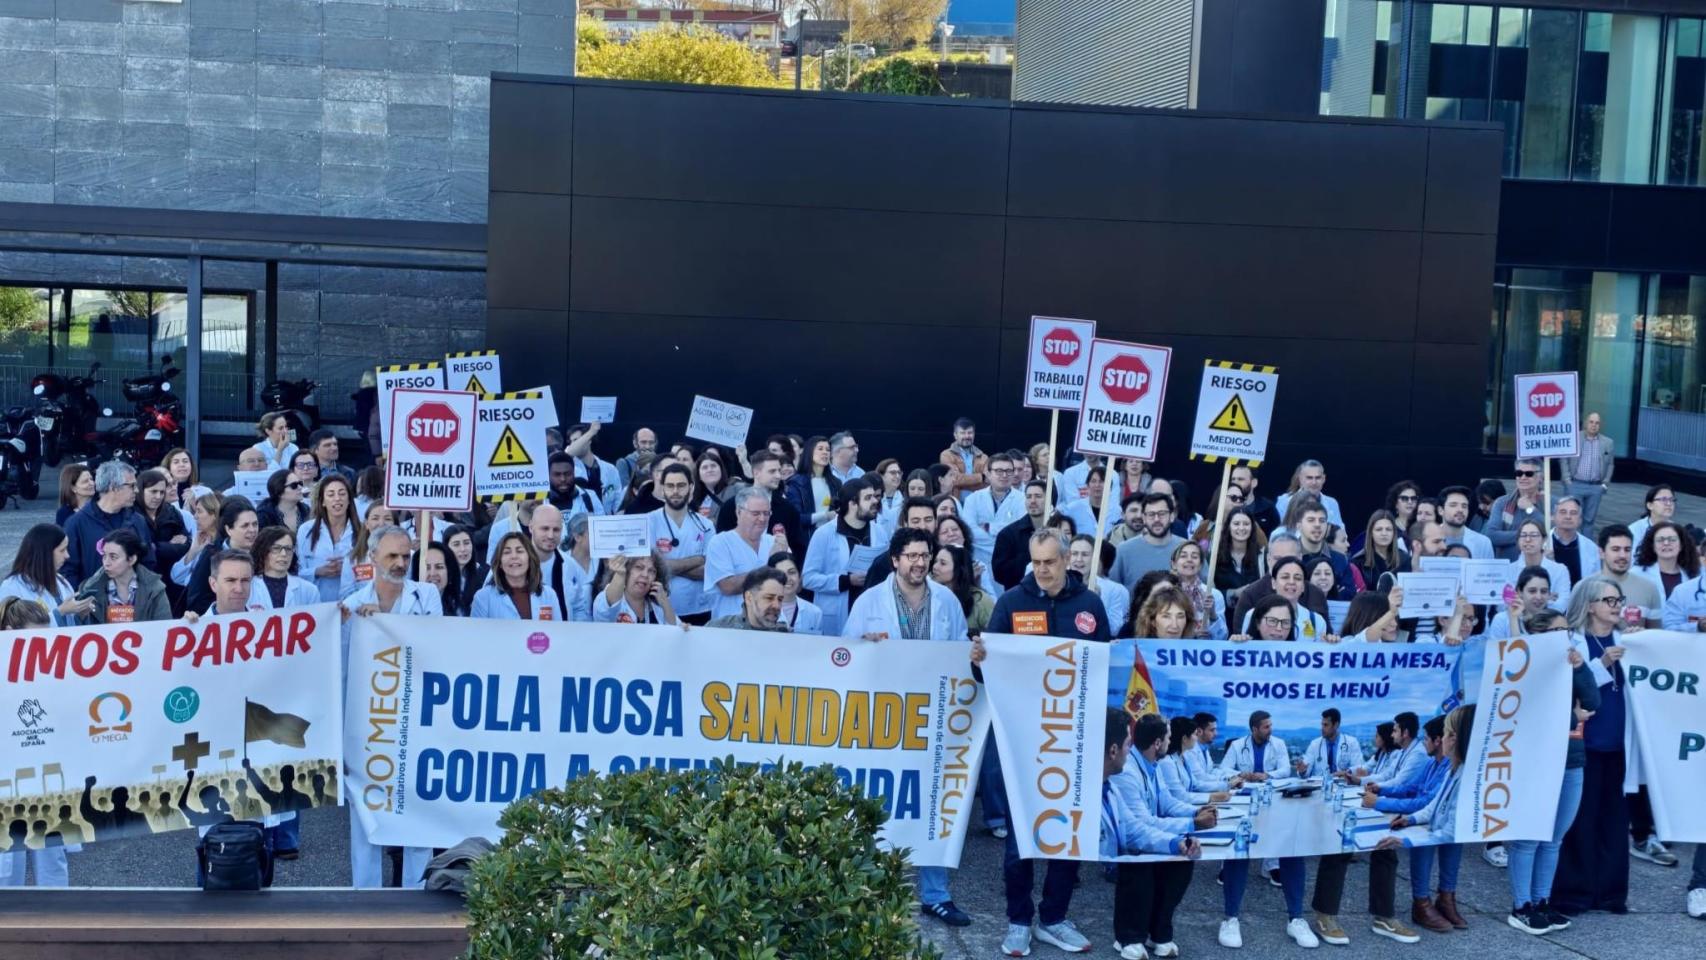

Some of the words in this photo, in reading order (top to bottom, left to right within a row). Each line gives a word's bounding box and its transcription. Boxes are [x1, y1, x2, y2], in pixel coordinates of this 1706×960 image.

[1045, 339, 1079, 356] STOP
[453, 361, 493, 374] RIESGO
[385, 376, 435, 390] RIESGO
[1034, 371, 1084, 386] TRABALLO
[1105, 368, 1148, 390] STOP
[1210, 375, 1267, 392] RIESGO
[1034, 387, 1050, 399] SEN
[1052, 386, 1081, 401] LÍMITE
[1530, 392, 1564, 408] STOP
[479, 407, 535, 422] RIESGO
[1088, 408, 1152, 430] TRABALLO
[410, 418, 456, 438] STOP
[1523, 423, 1572, 436] TRABALLO
[1087, 428, 1108, 443] SEN
[1110, 428, 1148, 448] LÍMITE
[1208, 434, 1252, 447] MEDICO
[1525, 439, 1541, 450] SEN
[1543, 436, 1571, 449] LÍMITE
[397, 461, 465, 479] TRABALLO
[490, 470, 534, 481] MEDICO
[397, 483, 422, 497] SEN
[423, 480, 462, 498] LÍMITE
[7, 630, 143, 683] IMOS
[161, 612, 317, 672] PARAR
[835, 651, 849, 662] 30
[1156, 648, 1176, 667] SI
[1182, 648, 1216, 667] NO
[1221, 649, 1324, 669] ESTAMOS
[1329, 651, 1358, 669] EN
[1362, 651, 1386, 669] LA
[1390, 651, 1451, 672] MESA,
[403, 645, 413, 714] Independentes
[1078, 646, 1090, 710] Independentes
[1222, 681, 1300, 699] SOMOS
[1305, 682, 1327, 699] EL
[1330, 675, 1390, 699] MENÚ
[1628, 664, 1700, 696] POR
[420, 671, 541, 732] POLA
[559, 676, 684, 737] NOSA
[699, 681, 931, 751] SANIDADE
[937, 675, 948, 730] Facultativos
[12, 727, 55, 737] ASOCIACIÓN
[399, 715, 409, 747] Galicia
[1076, 711, 1086, 741] Galicia
[21, 740, 46, 748] ESPAÑA
[935, 731, 942, 741] de
[400, 748, 407, 760] de
[1077, 743, 1084, 754] de
[933, 742, 943, 775] Galicia
[415, 747, 547, 803] COIDA
[1073, 755, 1083, 807] Facultativos
[395, 765, 406, 815] Facultativos
[927, 775, 939, 842] Independentes
[1472, 771, 1483, 834] Independentes
